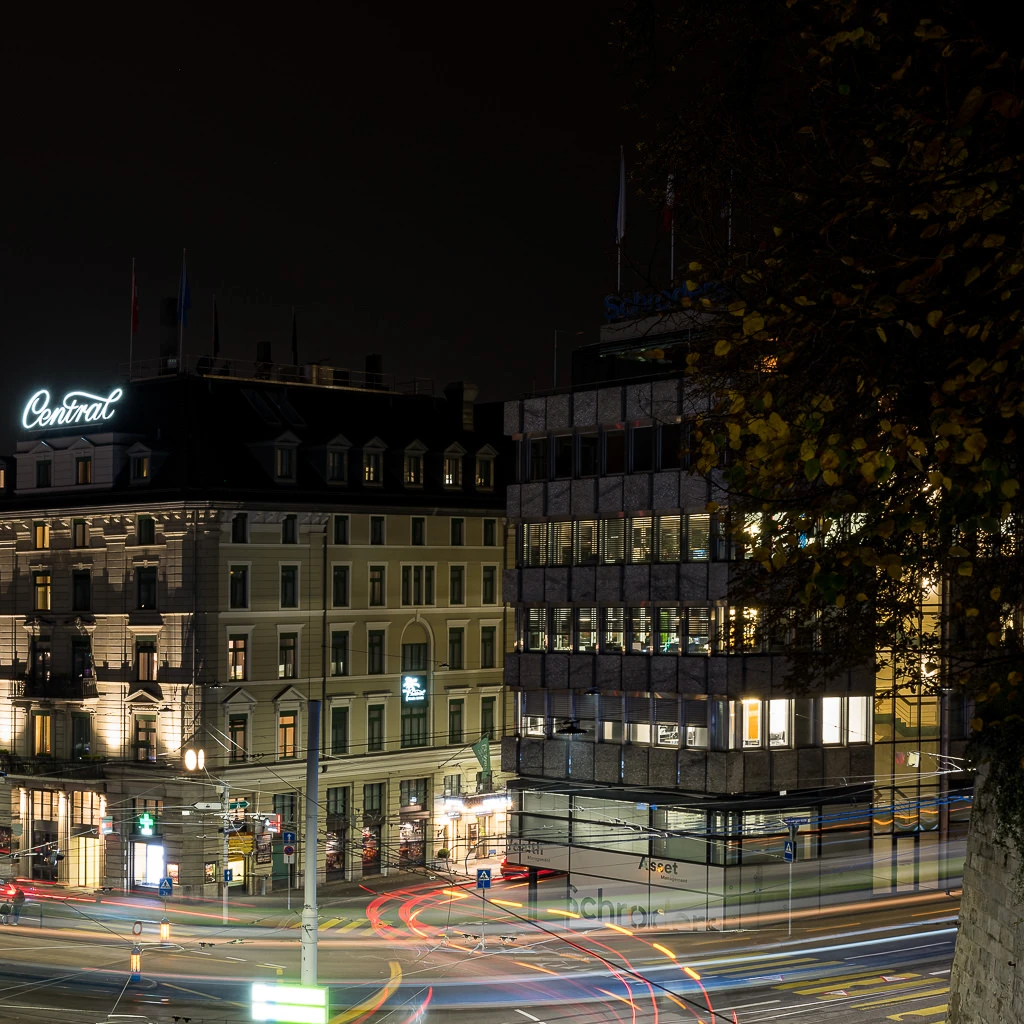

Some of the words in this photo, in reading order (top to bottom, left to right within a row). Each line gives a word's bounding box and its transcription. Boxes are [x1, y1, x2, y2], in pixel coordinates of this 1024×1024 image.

[23, 388, 123, 429] Central
[638, 856, 679, 875] Asset
[660, 875, 688, 884] Management
